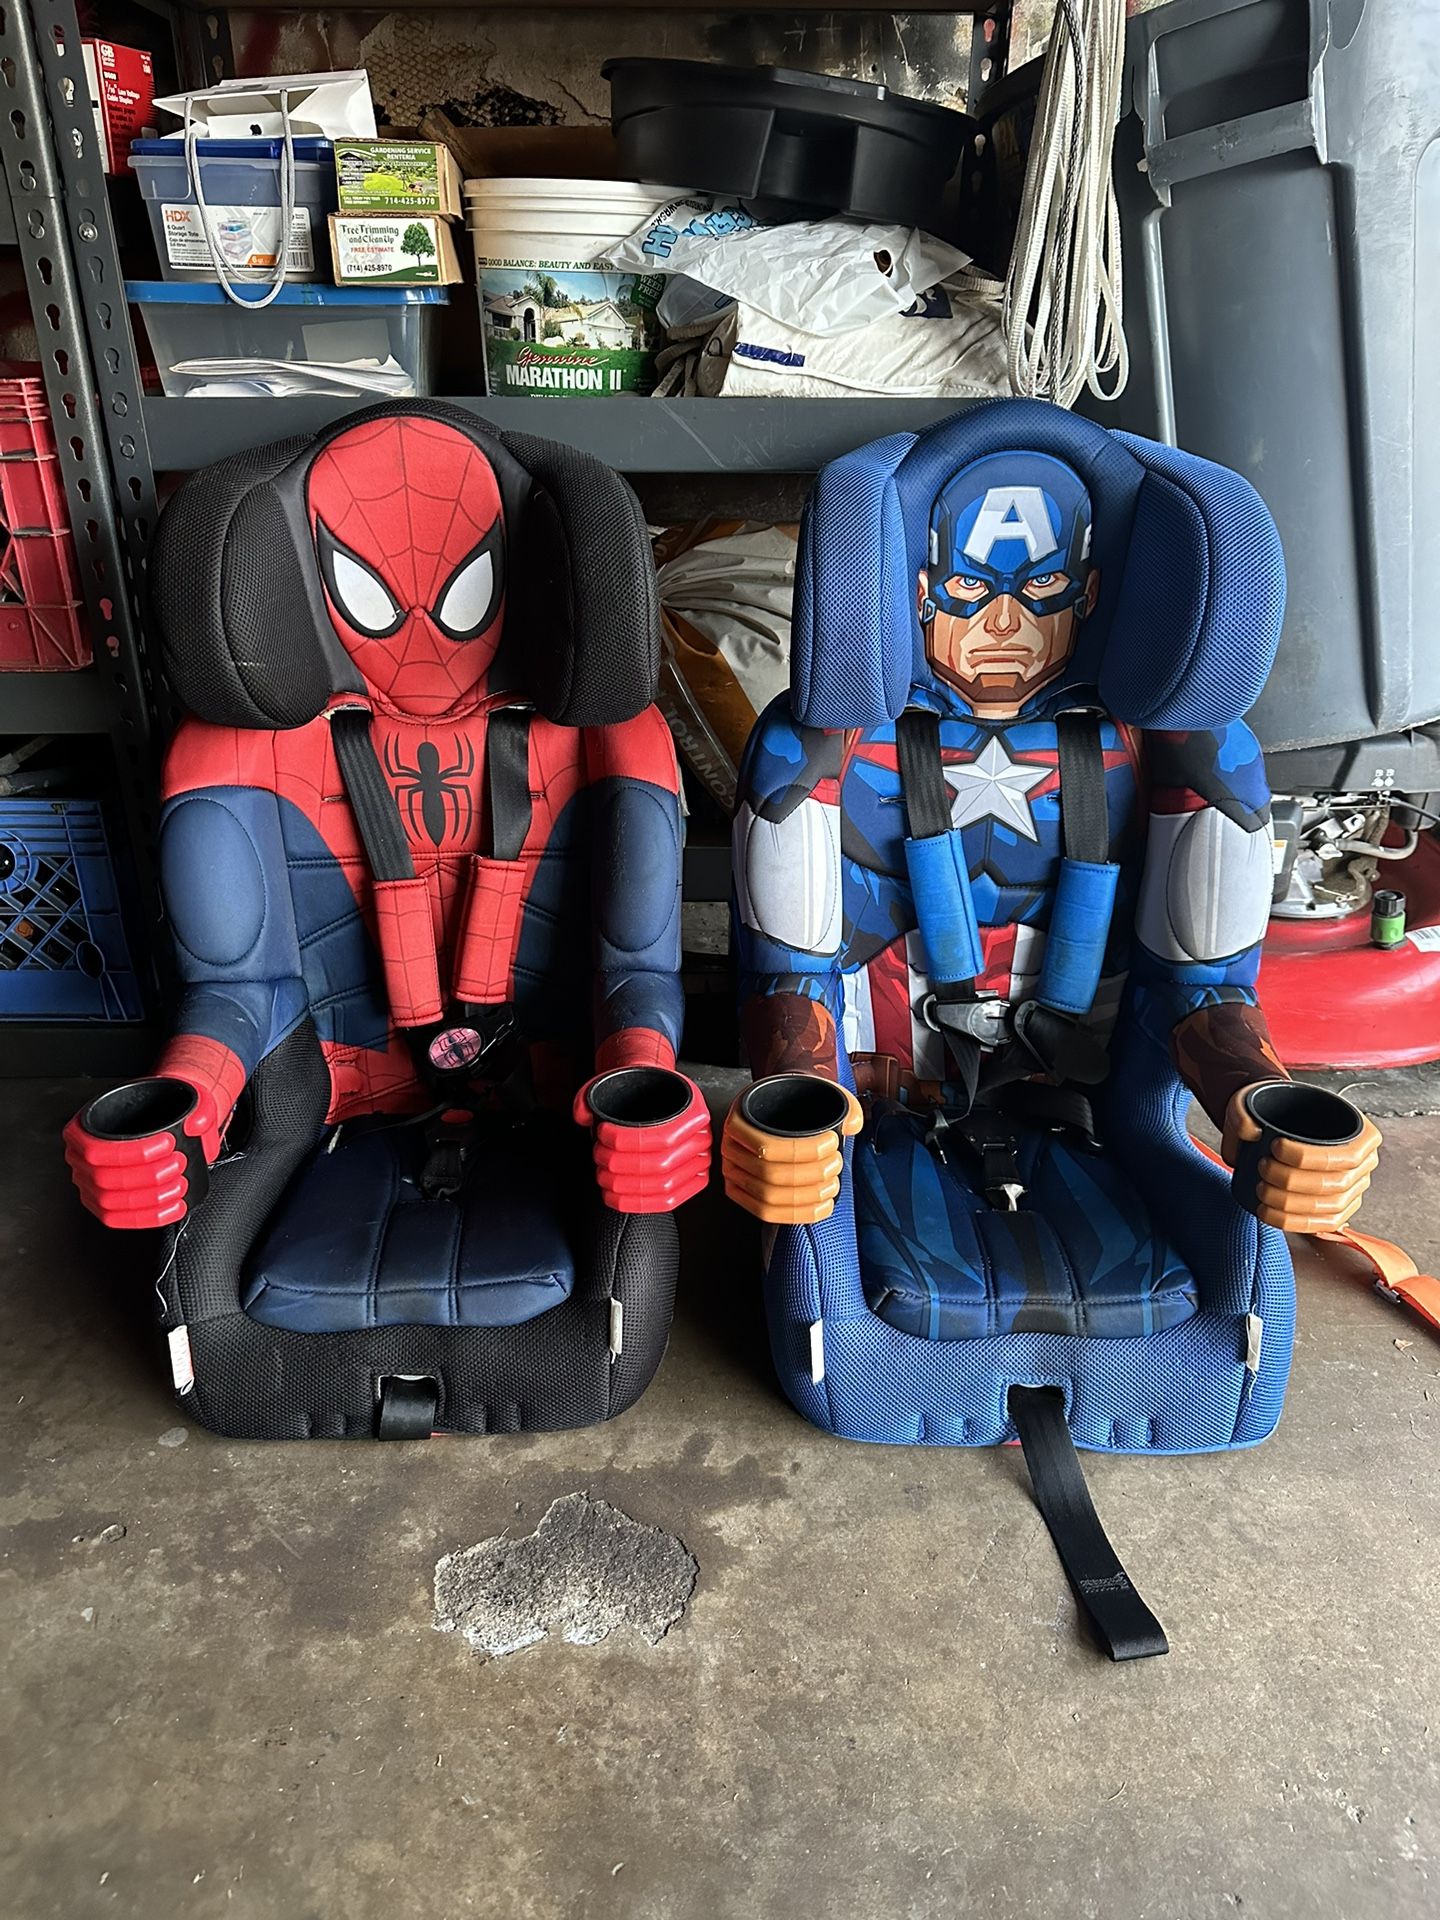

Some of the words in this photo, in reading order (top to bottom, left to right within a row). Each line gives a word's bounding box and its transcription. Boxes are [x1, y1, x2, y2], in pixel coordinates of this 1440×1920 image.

[385, 197, 435, 205] 714-425-8970
[165, 210, 191, 222] HDX
[341, 224, 359, 234] Tree
[359, 224, 399, 236] Trimming
[349, 236, 362, 244] and
[347, 264, 363, 273] (714)
[364, 264, 392, 272] 425-8970
[503, 259, 537, 268] BALANCE:
[538, 260, 572, 269] BEAUTY
[573, 261, 591, 270] AND
[593, 262, 616, 271] EASY
[640, 274, 663, 292] WEED
[638, 283, 660, 299] FREE
[516, 346, 609, 367] Genuine
[505, 364, 603, 390] MARATHON
[609, 369, 622, 390] II
[963, 486, 1058, 564] A
